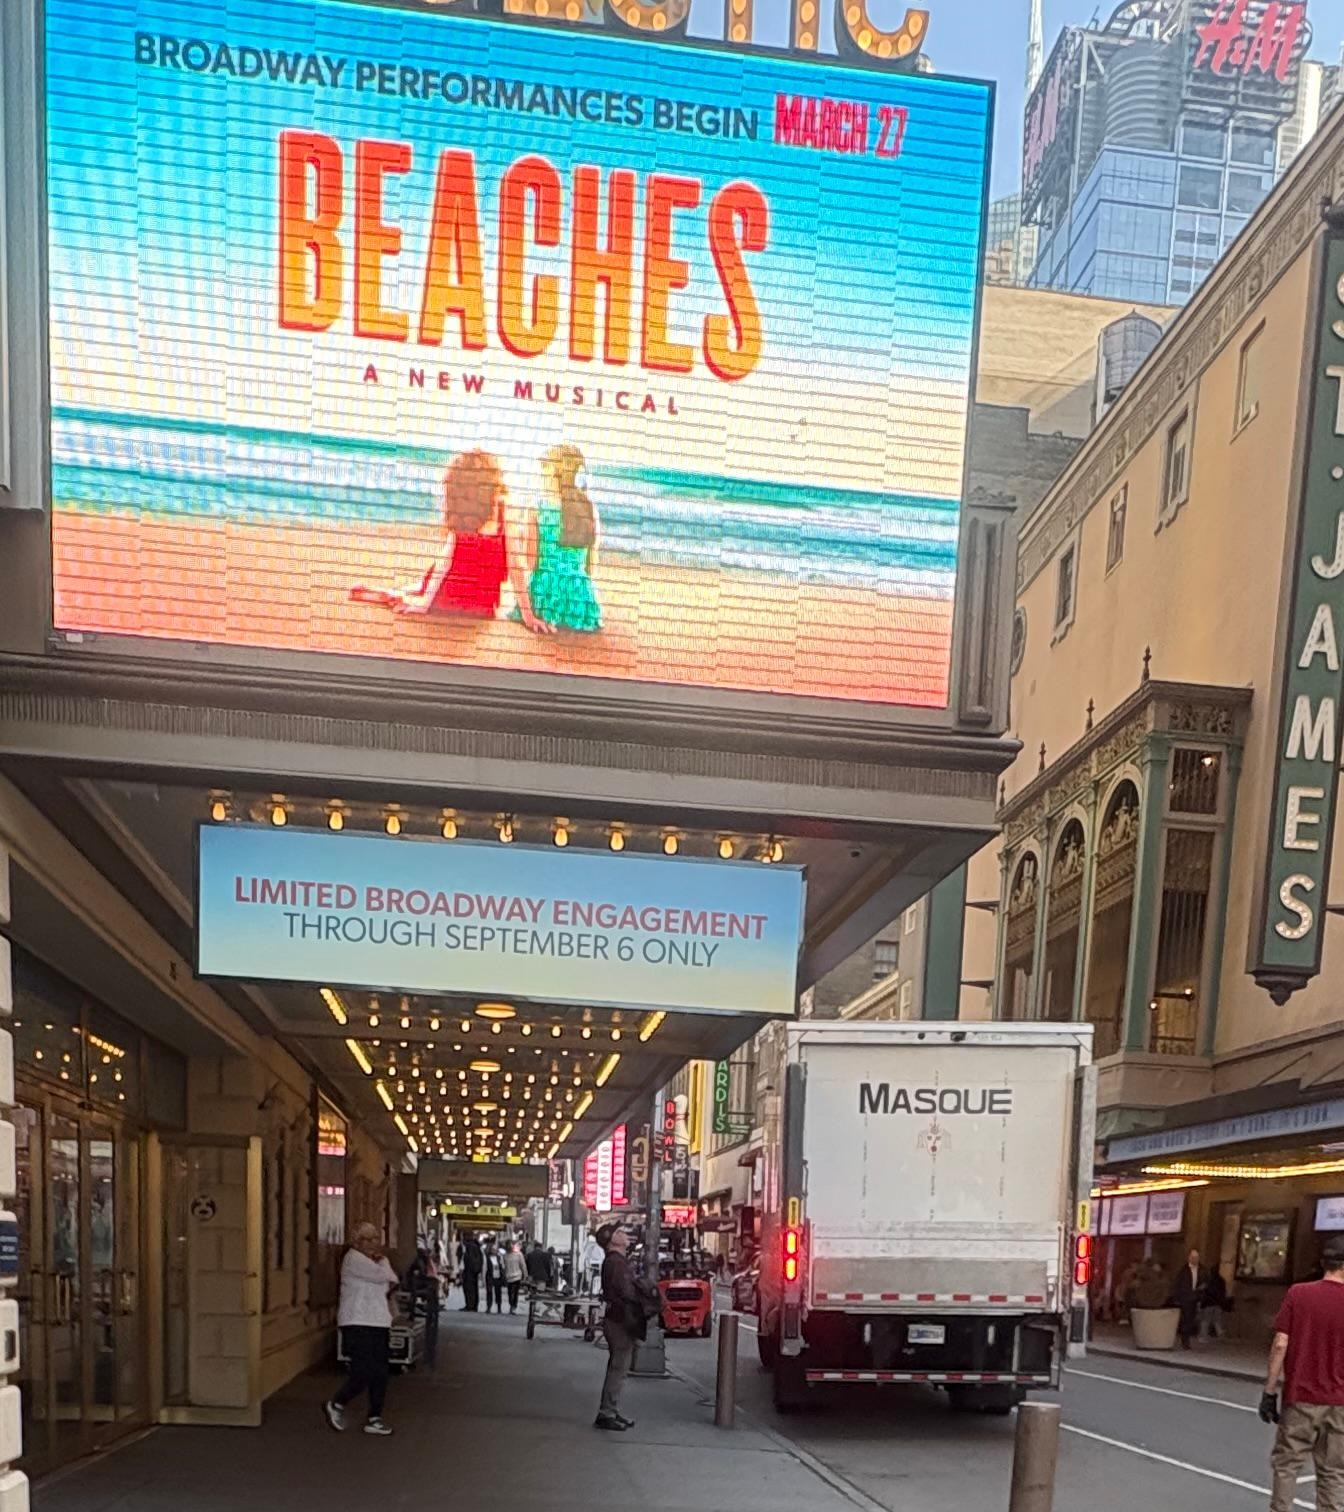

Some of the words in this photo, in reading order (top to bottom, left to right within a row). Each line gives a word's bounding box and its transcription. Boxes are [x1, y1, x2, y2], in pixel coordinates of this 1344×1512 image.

[1194, 0, 1304, 82] H&M
[134, 31, 347, 89] BROADWAY
[357, 61, 643, 126] PERFORMANCES
[653, 99, 759, 141] BEGIN
[773, 91, 869, 156] MARCH
[874, 105, 908, 159] 27
[277, 128, 770, 382] BEACHES
[362, 363, 380, 384] A
[409, 368, 485, 394] NEW
[514, 381, 680, 416] MUSICAL
[234, 875, 357, 910] LIMITED
[364, 887, 545, 925] BROADWAY
[552, 899, 768, 941] ENGAGEMENT
[282, 911, 436, 948] THROUGH
[444, 923, 609, 961] SEPTEMBER
[617, 935, 635, 963] 6
[642, 938, 720, 968] ONLY
[859, 1082, 1013, 1115] MASQUE
